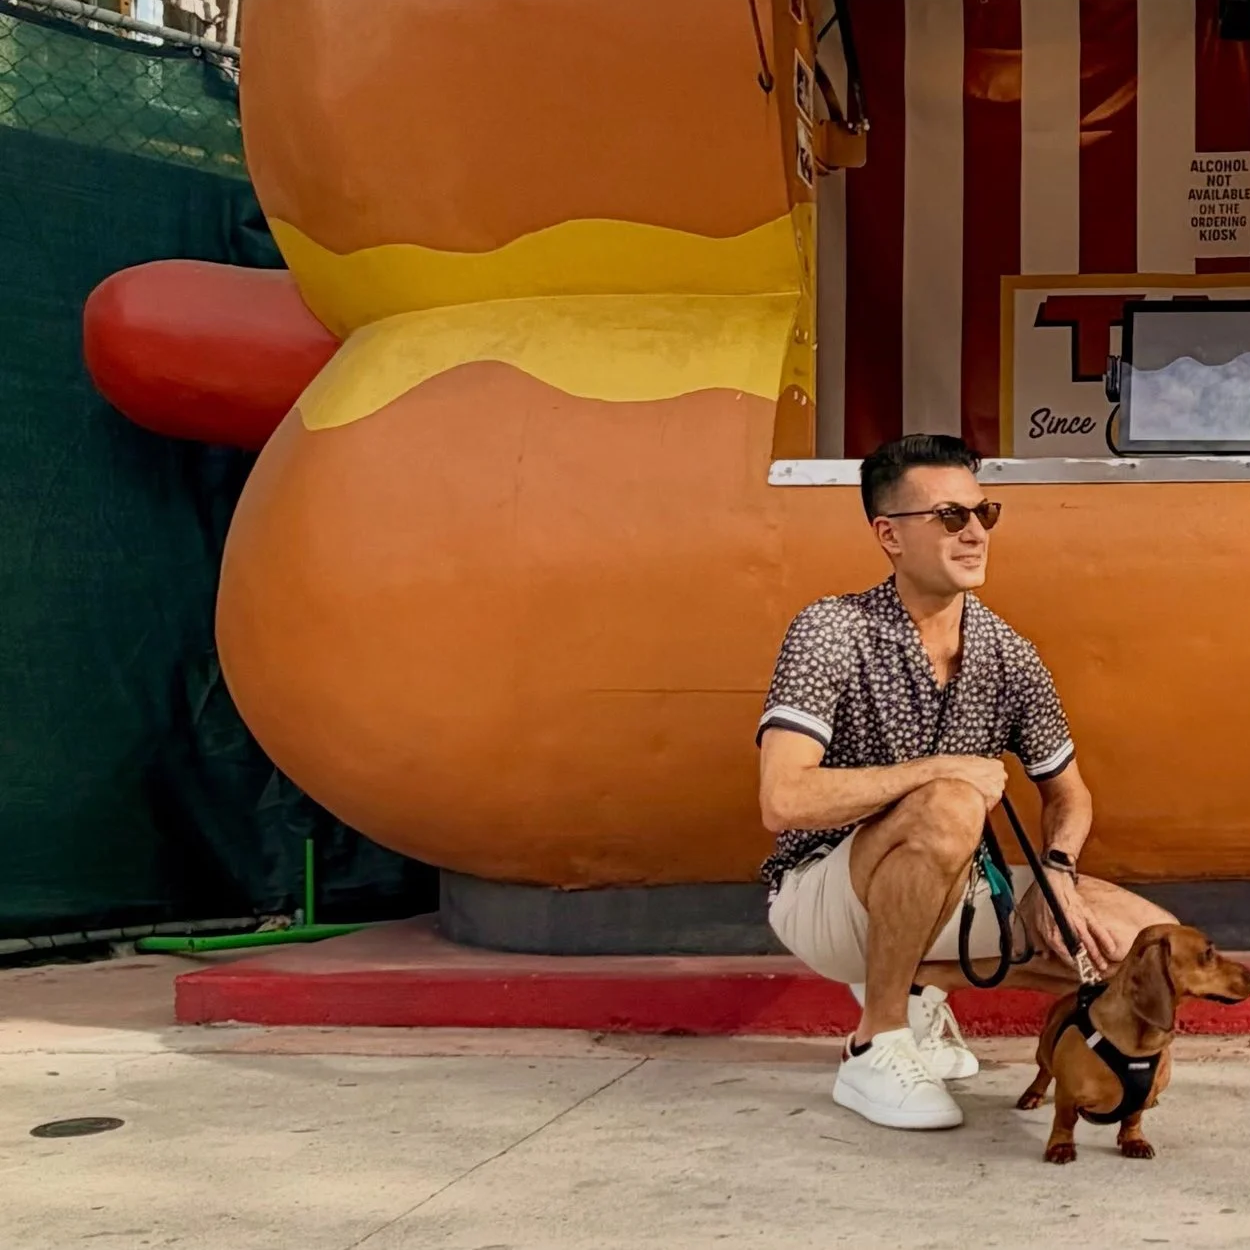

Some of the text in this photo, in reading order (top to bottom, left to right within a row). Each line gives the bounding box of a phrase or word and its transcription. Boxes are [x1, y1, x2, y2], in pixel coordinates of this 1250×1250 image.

[1190, 159, 1249, 172] ALCOHOL
[1207, 174, 1232, 187] NOT
[1188, 188, 1250, 200] AVAILABLE
[1200, 203, 1240, 215] ON THE
[1191, 216, 1247, 227] ORDERING
[1200, 229, 1237, 241] KIOSK
[1029, 407, 1096, 439] Since
